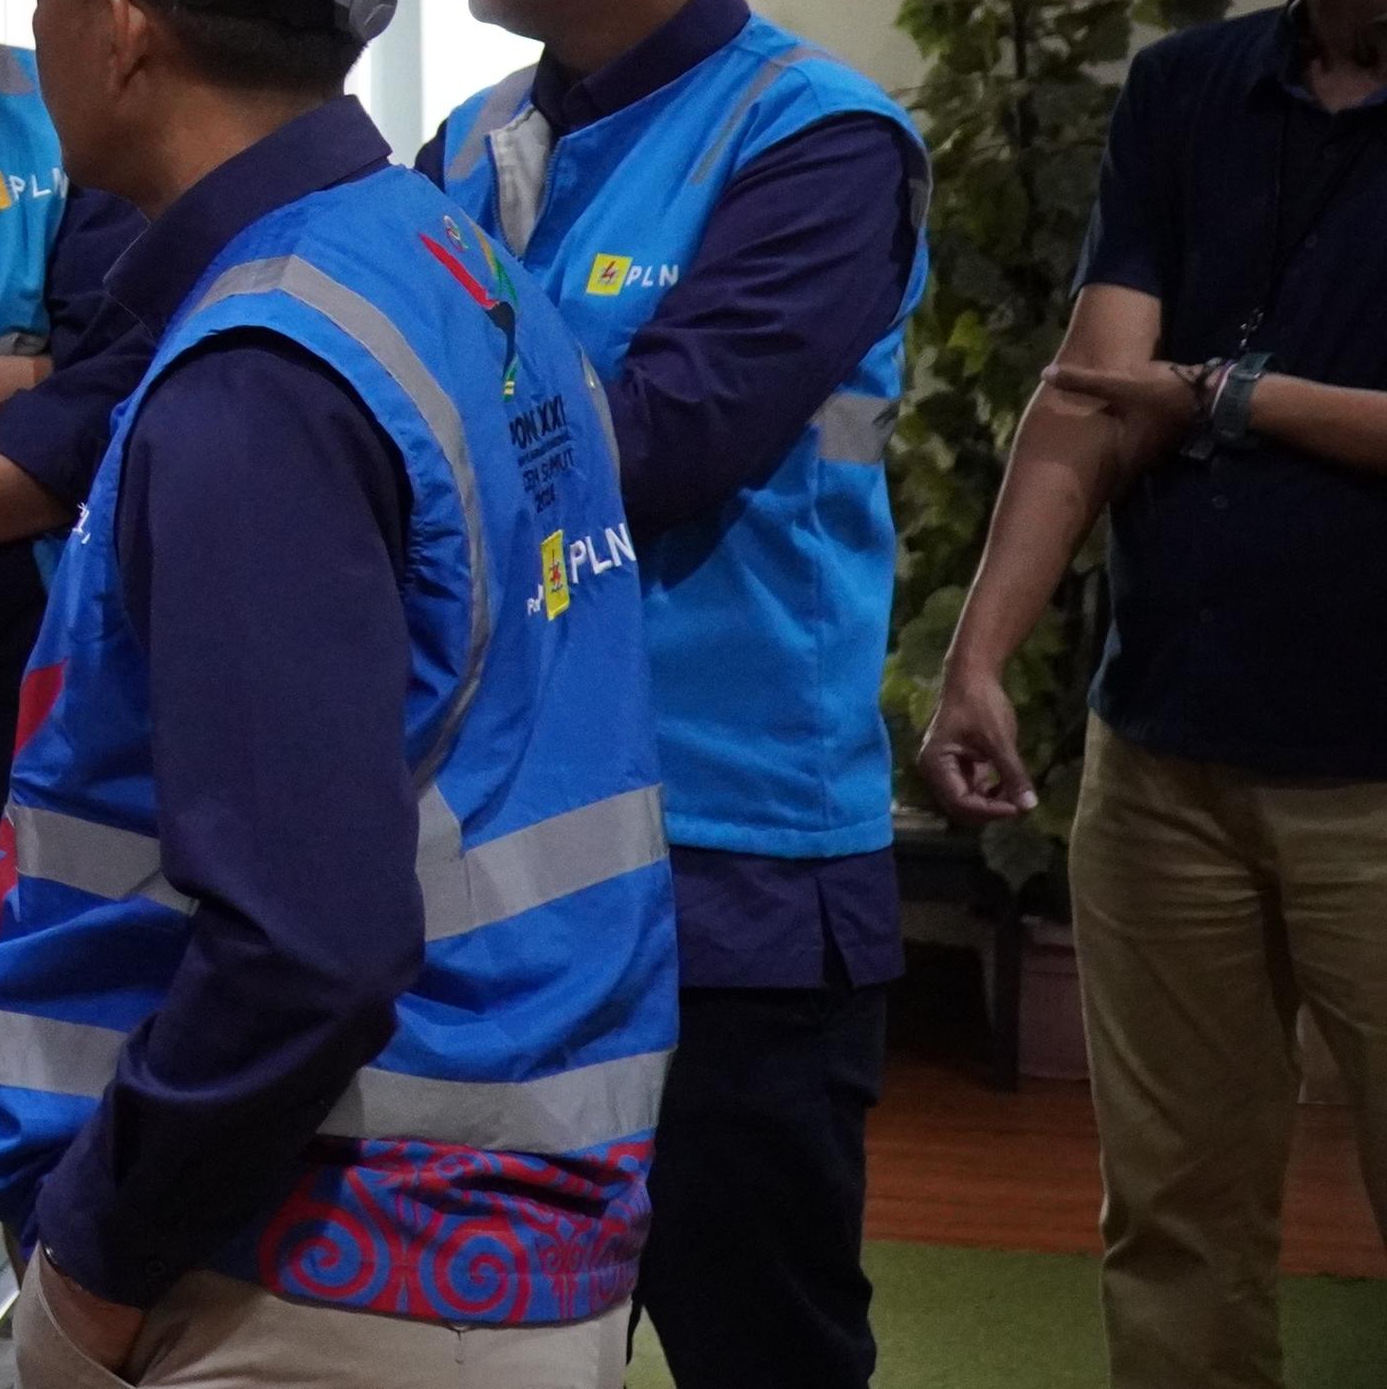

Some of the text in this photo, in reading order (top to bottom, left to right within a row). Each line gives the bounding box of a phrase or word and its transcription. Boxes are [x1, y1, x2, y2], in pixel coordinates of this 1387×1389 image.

[8, 167, 69, 201] PLN
[626, 263, 680, 288] PLN
[569, 522, 637, 584] PLN
